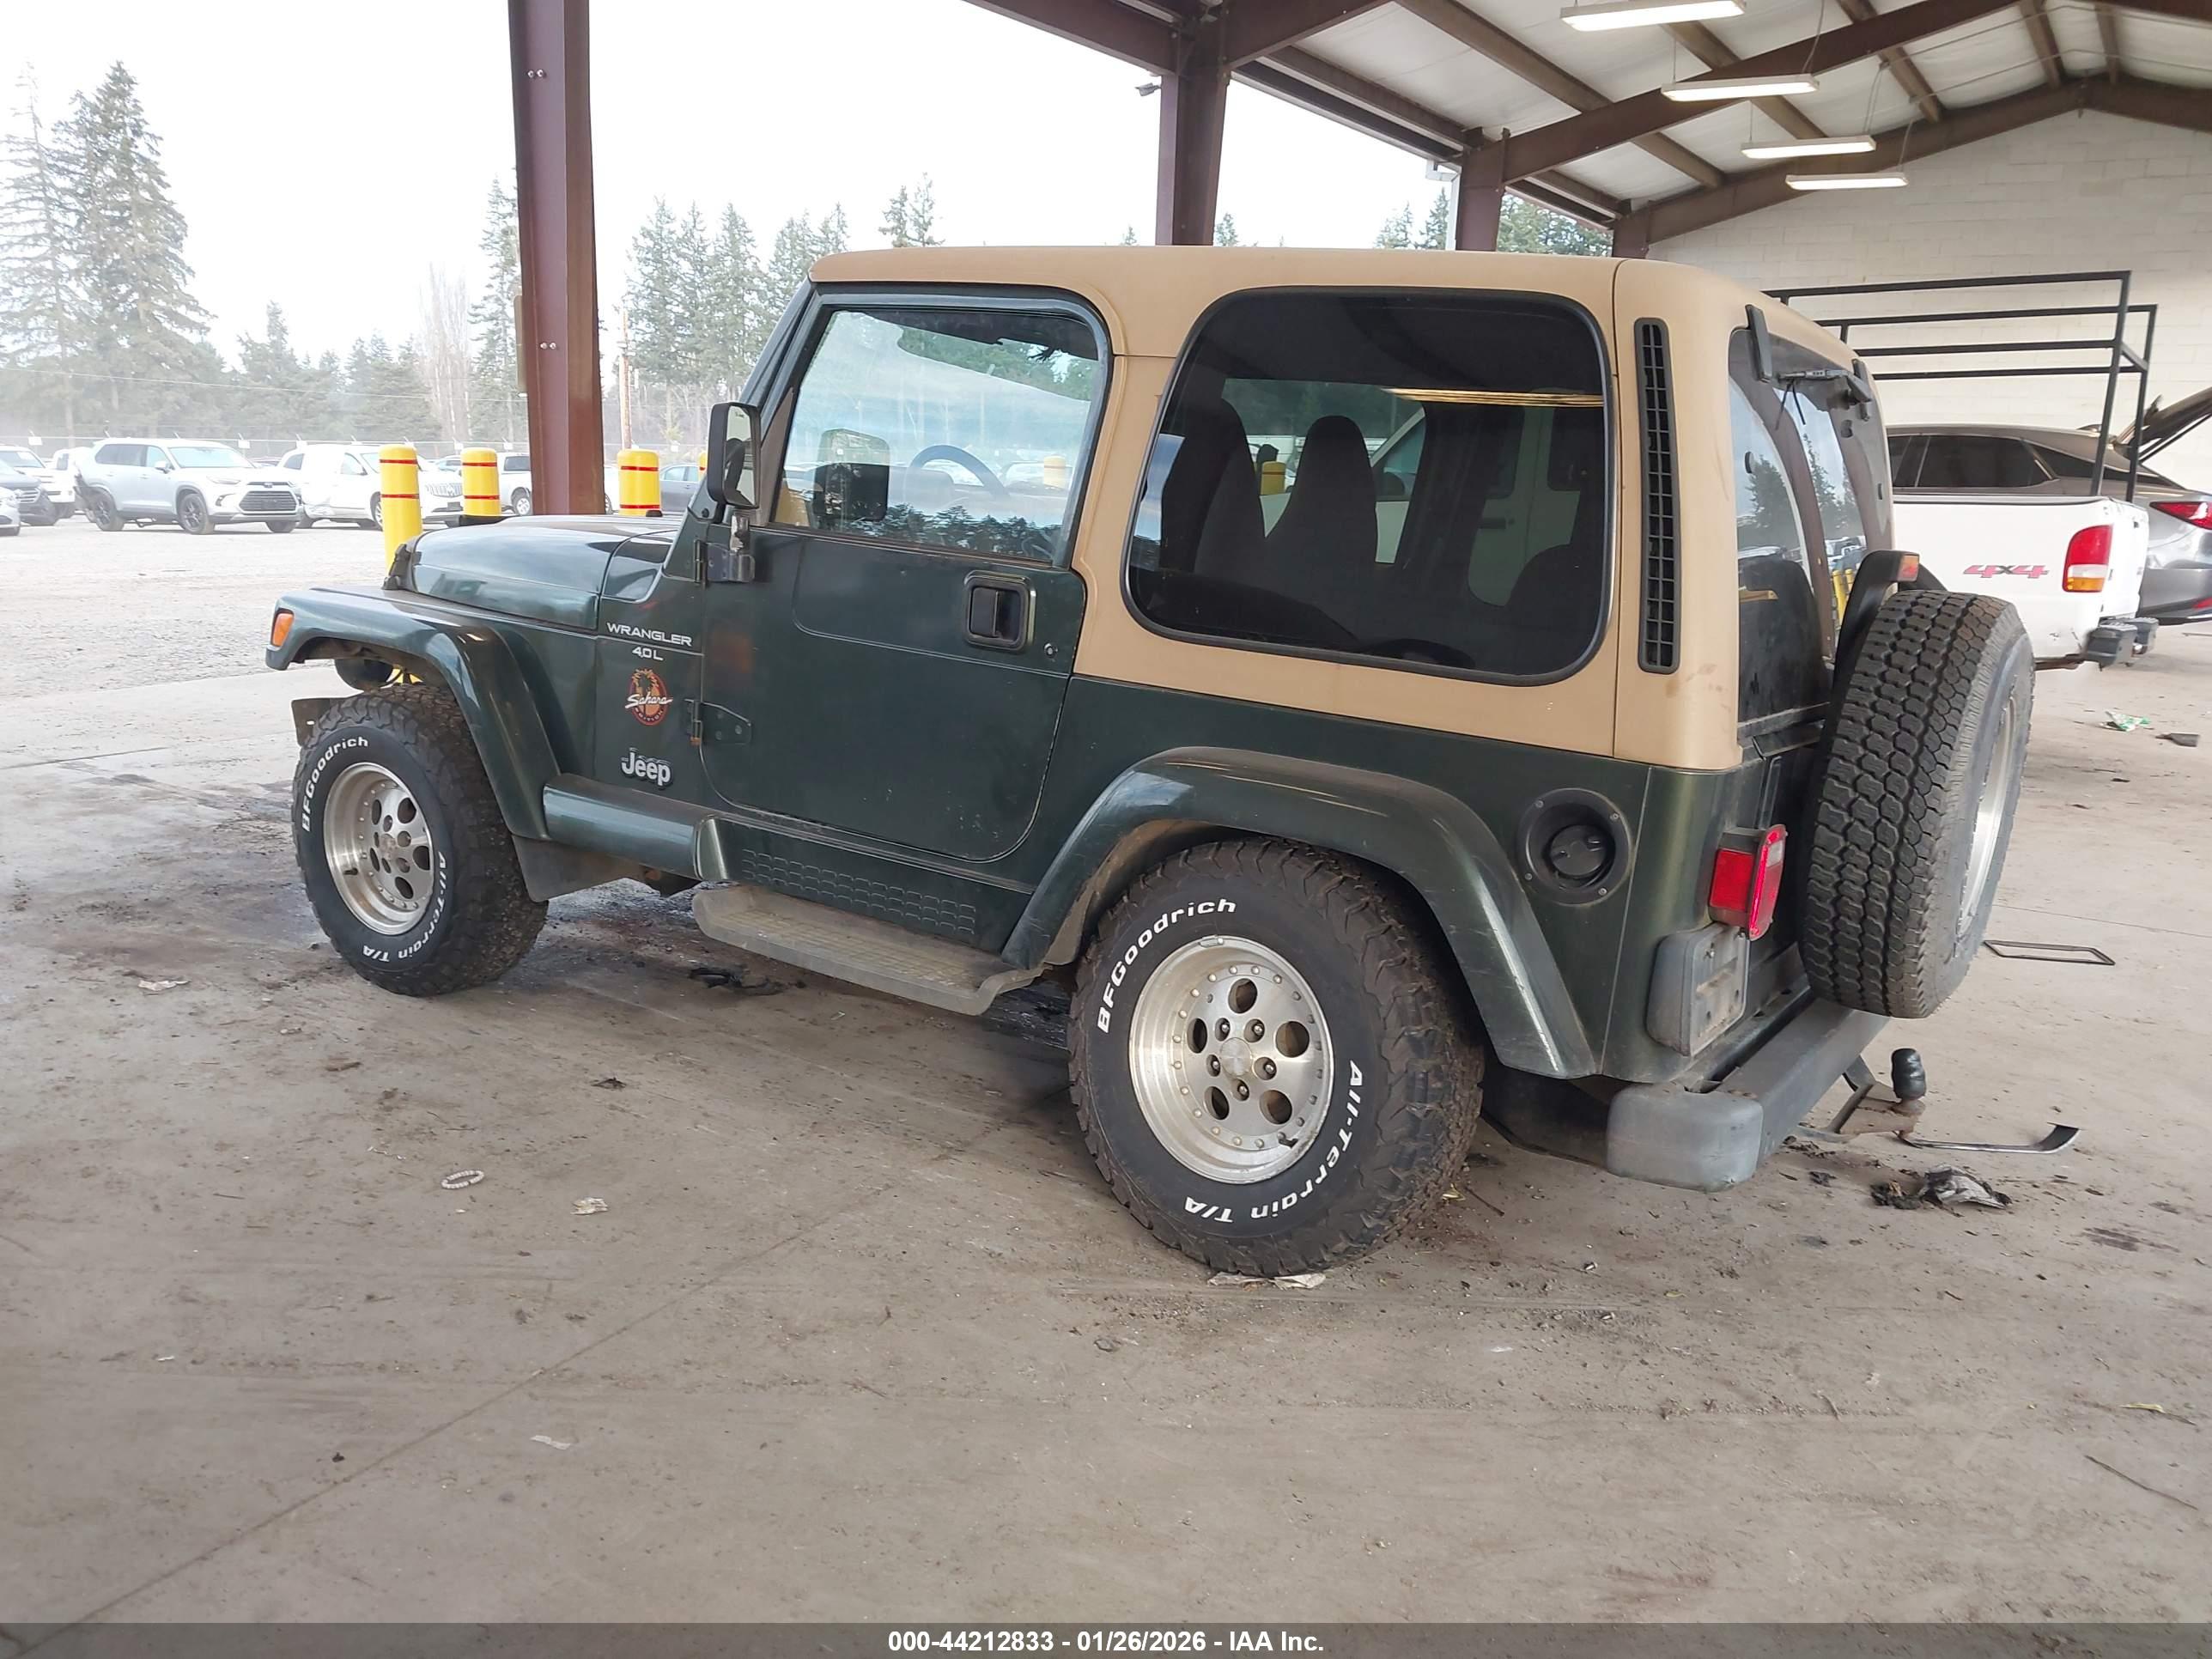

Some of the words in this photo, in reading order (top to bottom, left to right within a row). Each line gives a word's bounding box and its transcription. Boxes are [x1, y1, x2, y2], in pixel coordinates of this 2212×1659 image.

[607, 622, 692, 646] WRANGLER
[624, 691, 673, 709] Sahara
[301, 735, 370, 833] BFGoodrich
[621, 748, 671, 786] Jeep
[398, 850, 448, 960] All-Terrain
[362, 944, 391, 963] T/A
[1096, 897, 1237, 1035] BFGoodrich
[1250, 1059, 1365, 1220] All-Terrain
[1182, 1194, 1235, 1224] T/A
